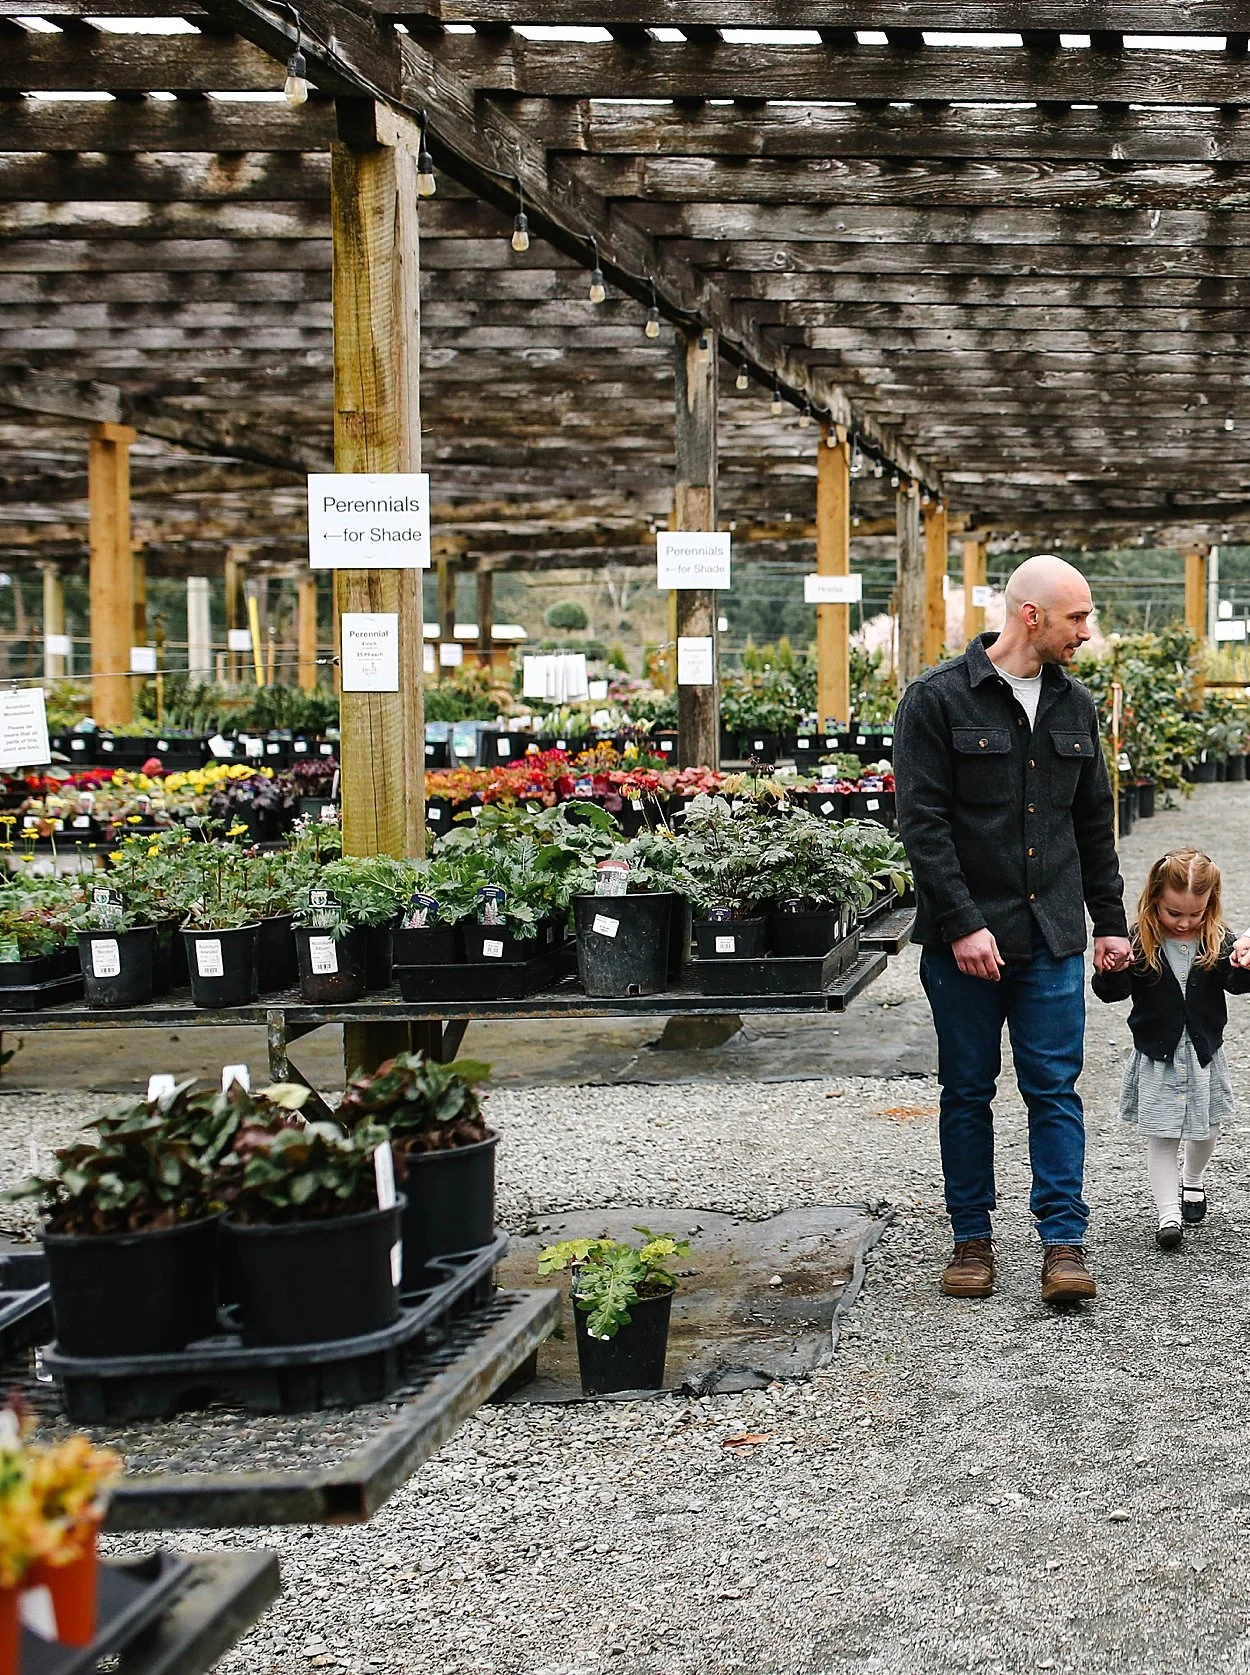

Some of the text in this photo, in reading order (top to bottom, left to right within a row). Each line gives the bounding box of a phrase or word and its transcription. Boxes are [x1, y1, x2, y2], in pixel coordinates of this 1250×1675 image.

[323, 496, 420, 513] Perennials
[343, 527, 422, 542] for Shade
[666, 545, 724, 556] Perennials
[678, 564, 725, 574] for Shade
[349, 630, 389, 638] Perennial
